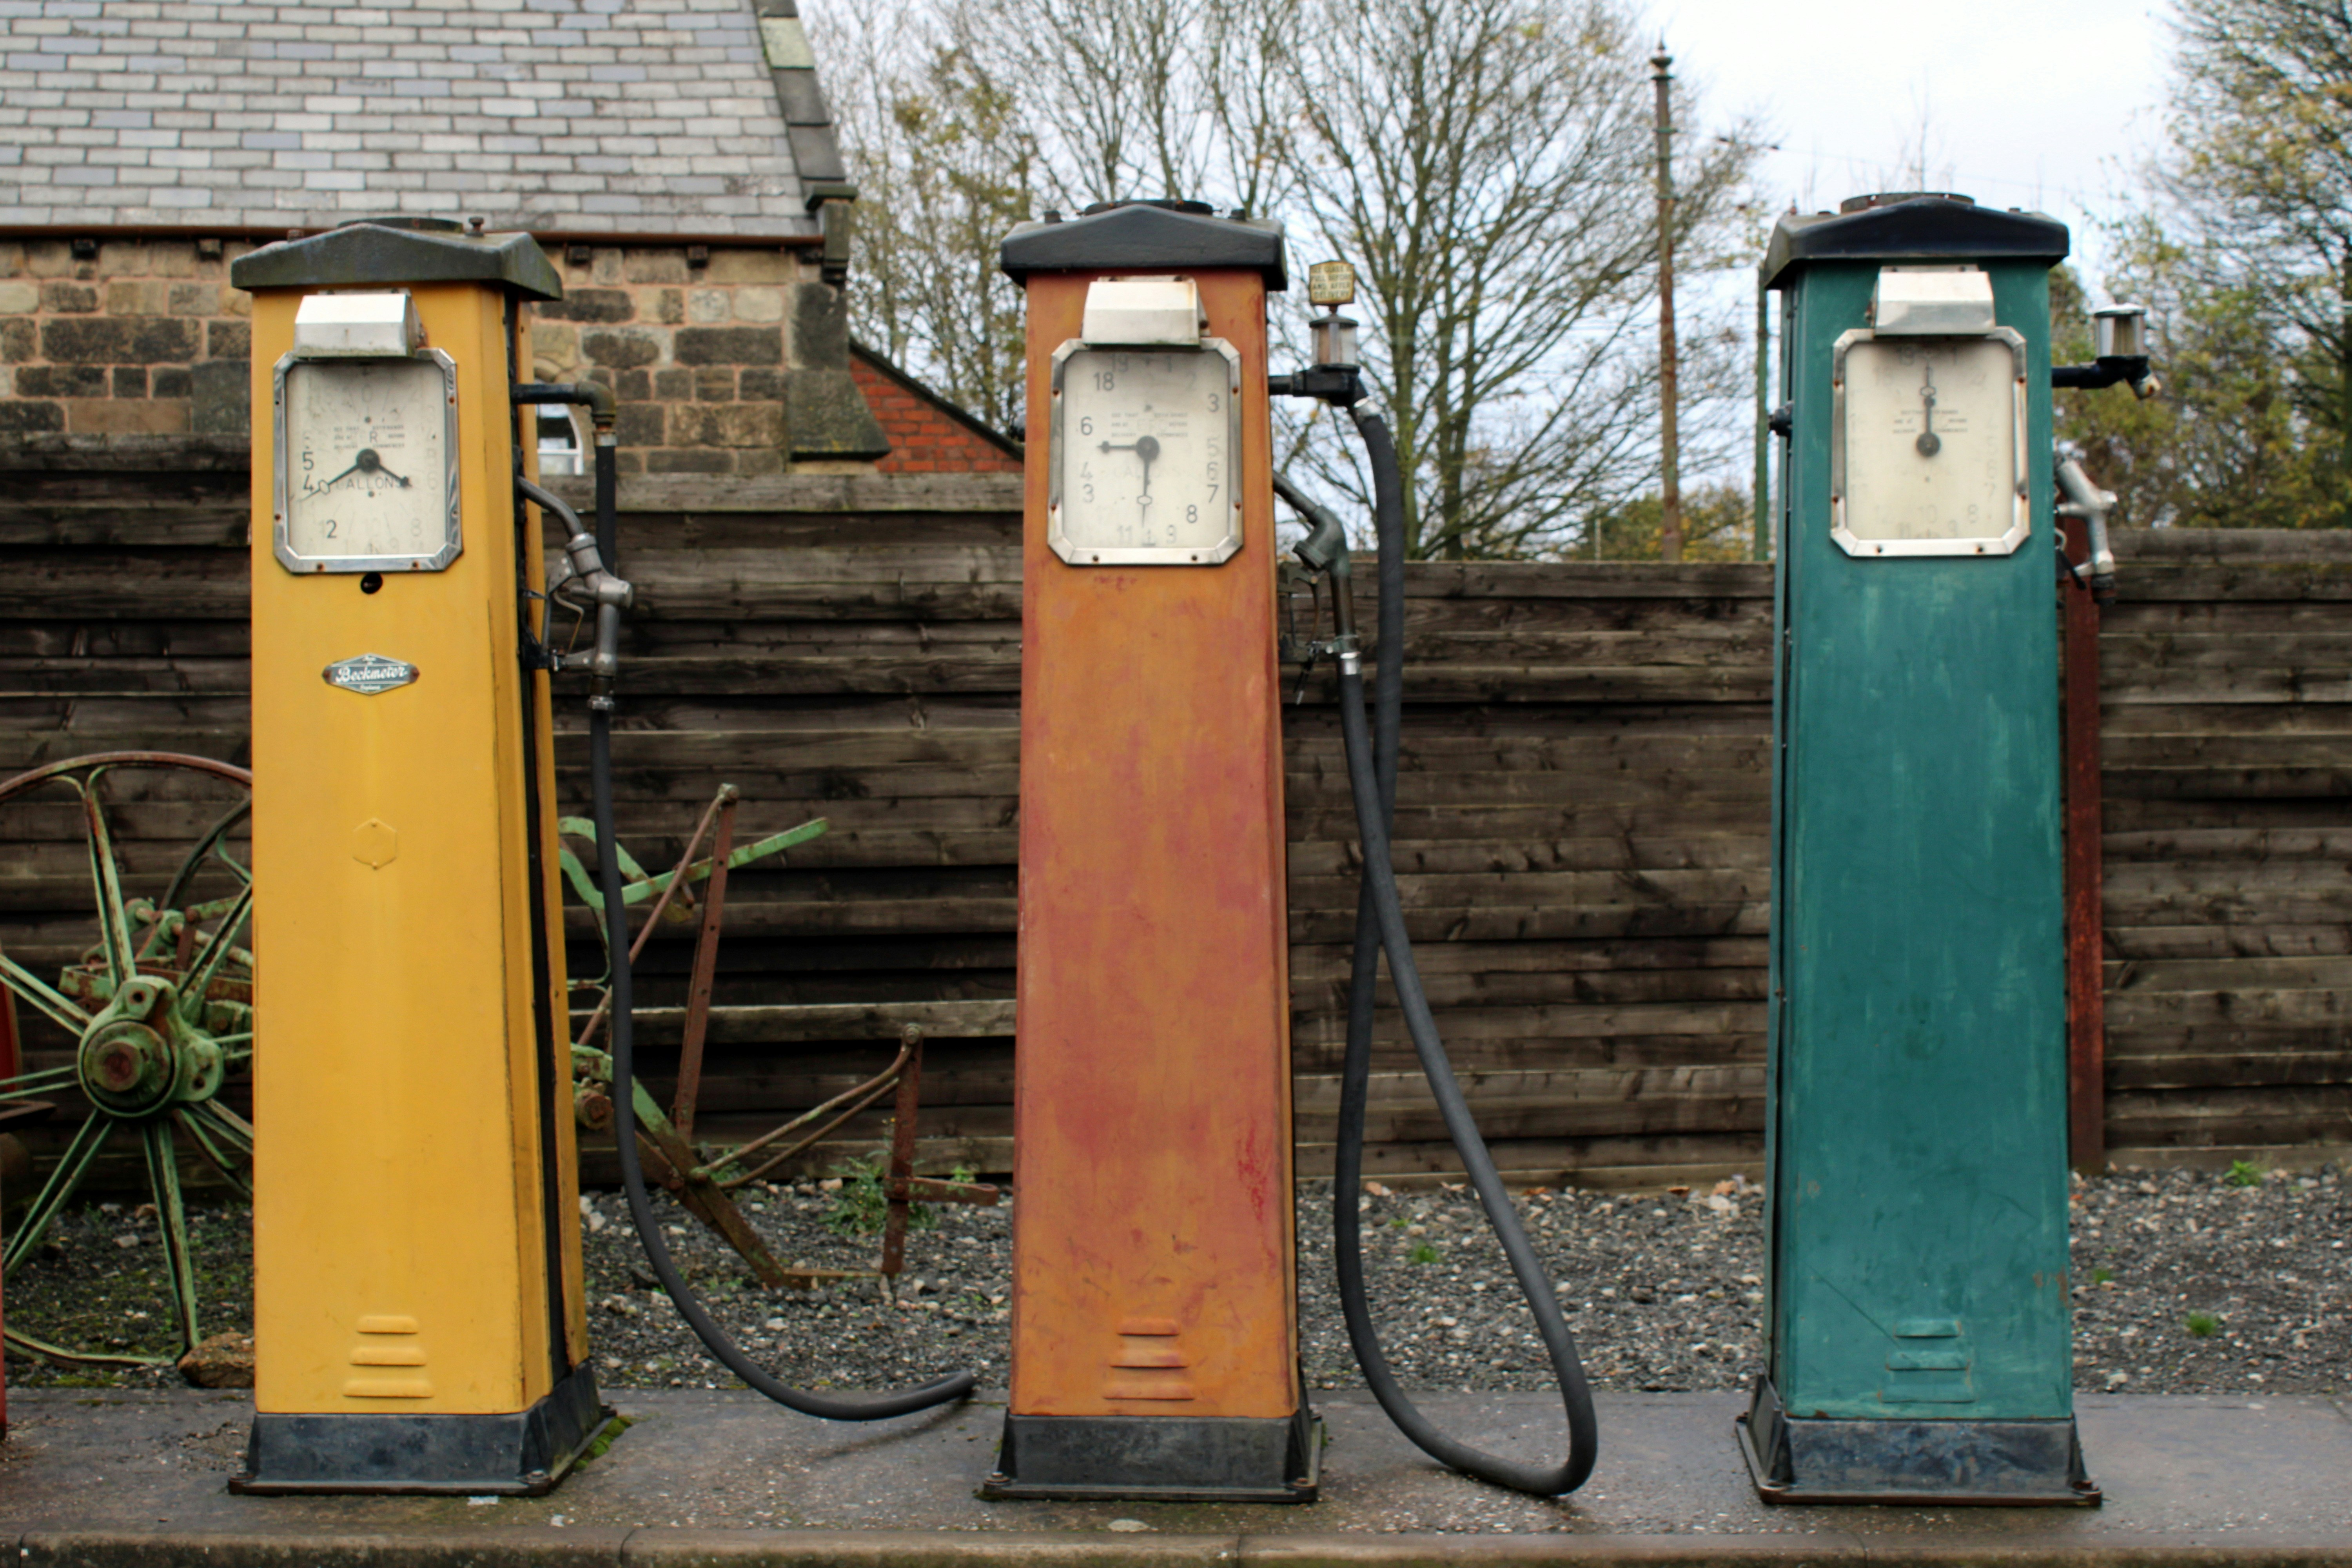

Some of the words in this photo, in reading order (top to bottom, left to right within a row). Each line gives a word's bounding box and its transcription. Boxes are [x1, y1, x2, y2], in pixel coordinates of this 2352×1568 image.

[1093, 372, 1115, 391] 18
[1207, 392, 1220, 412] 3
[1080, 416, 1093, 436] 6
[302, 451, 314, 470] 5
[303, 474, 315, 492] 4
[1082, 483, 1094, 503] 3
[1207, 484, 1219, 503] 7
[1186, 504, 1198, 524] 8
[336, 666, 408, 683] Beckmeter
